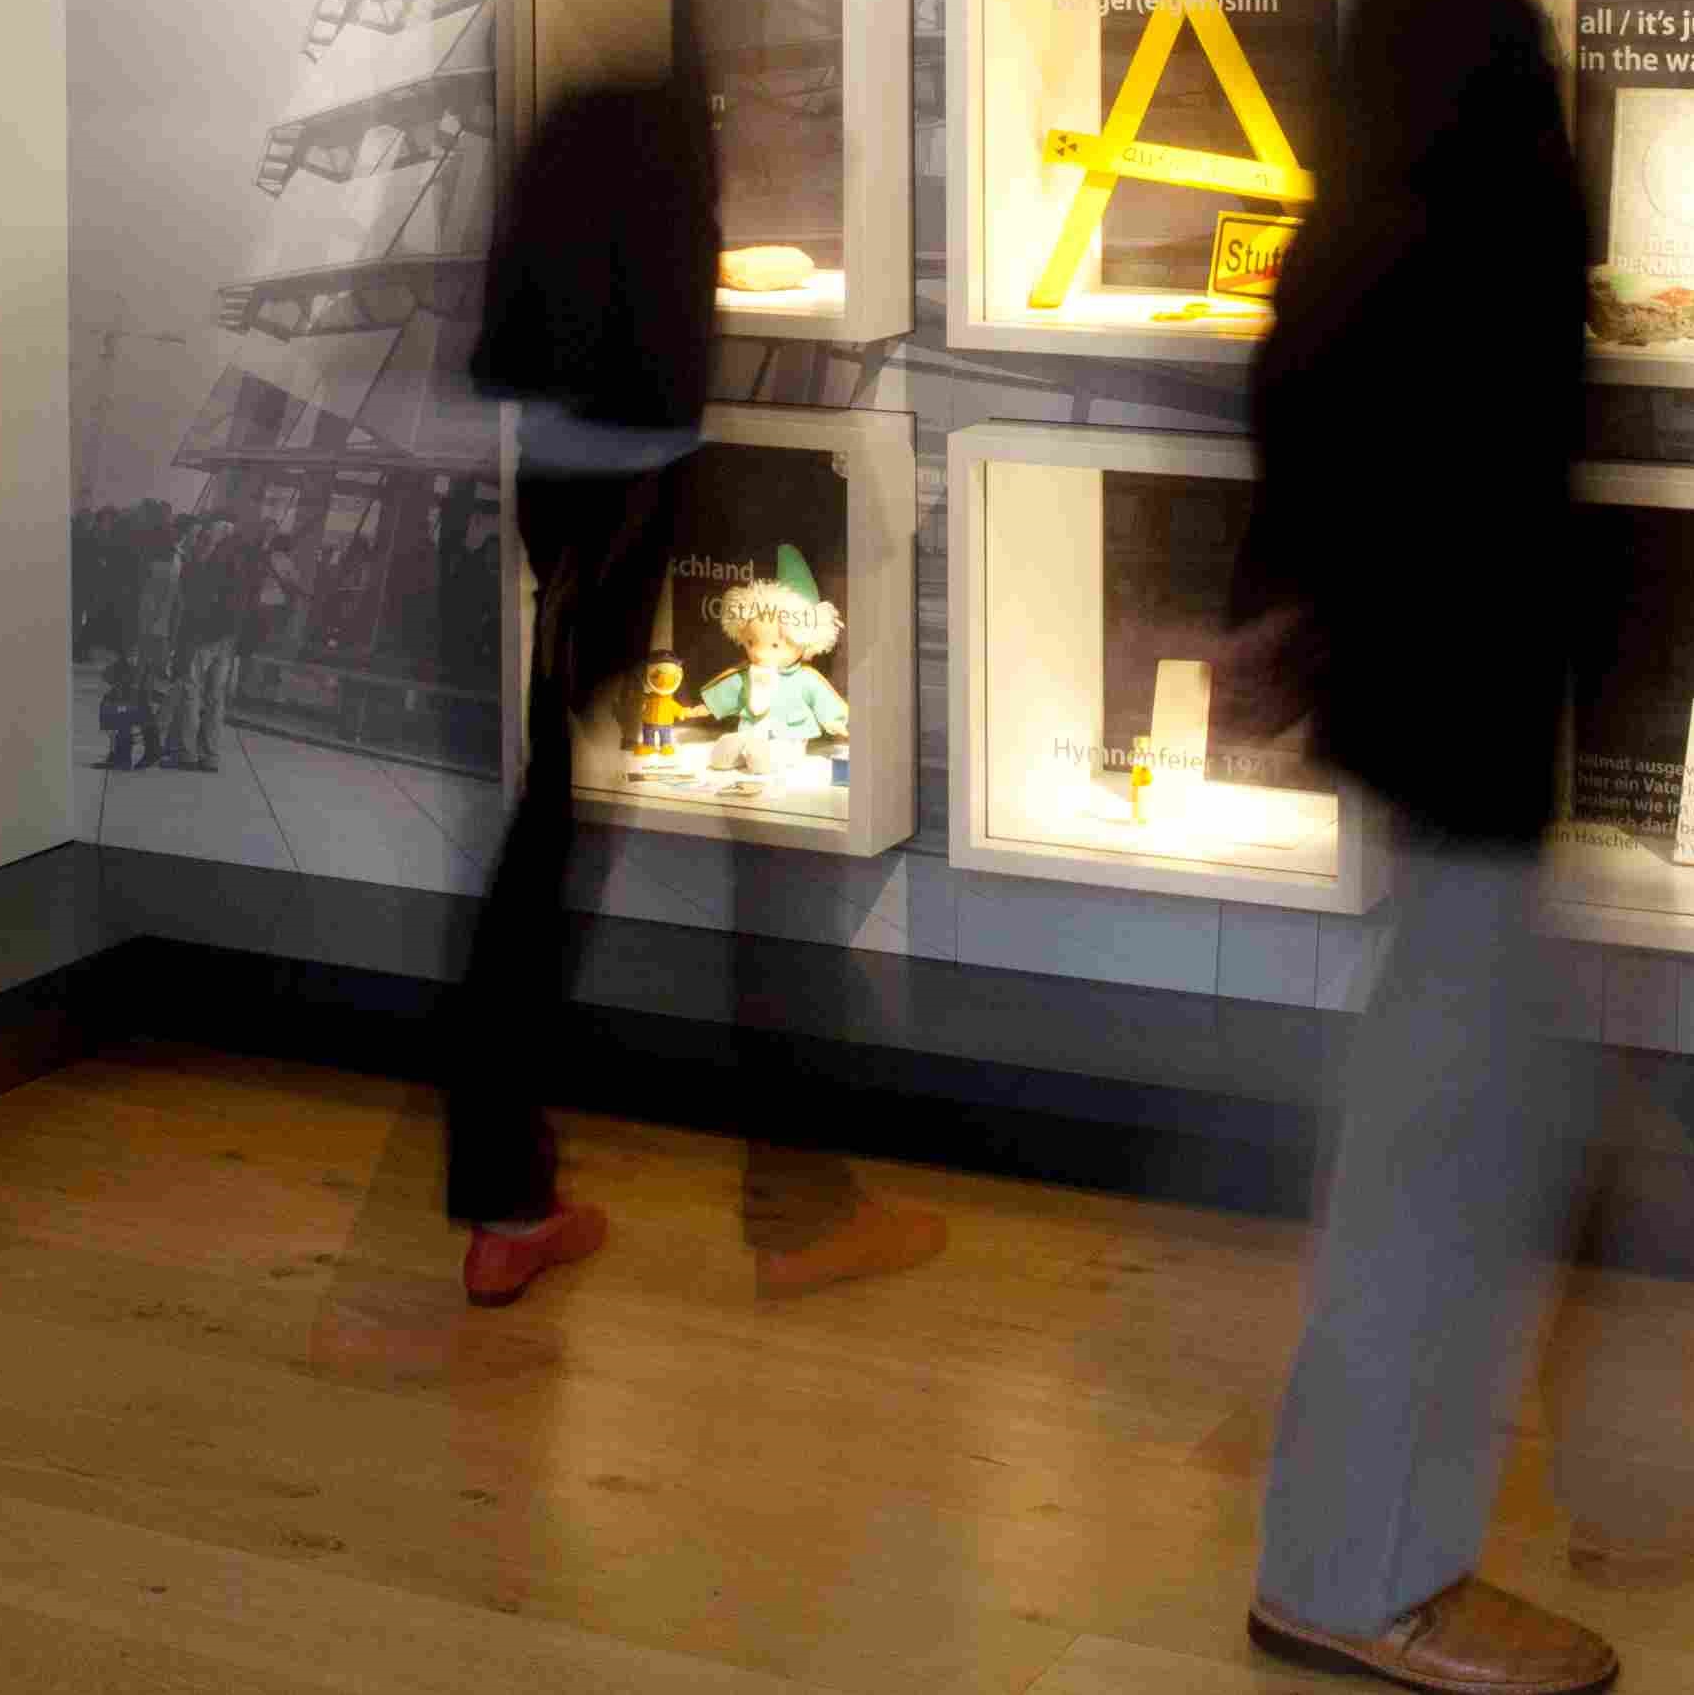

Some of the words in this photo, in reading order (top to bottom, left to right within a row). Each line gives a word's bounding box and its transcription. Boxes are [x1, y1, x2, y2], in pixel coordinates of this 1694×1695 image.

[1580, 7, 1612, 35] all
[1618, 9, 1631, 37] /
[1580, 45, 1605, 72] in
[1612, 45, 1659, 73] the
[700, 593, 818, 629] (Ost/West)
